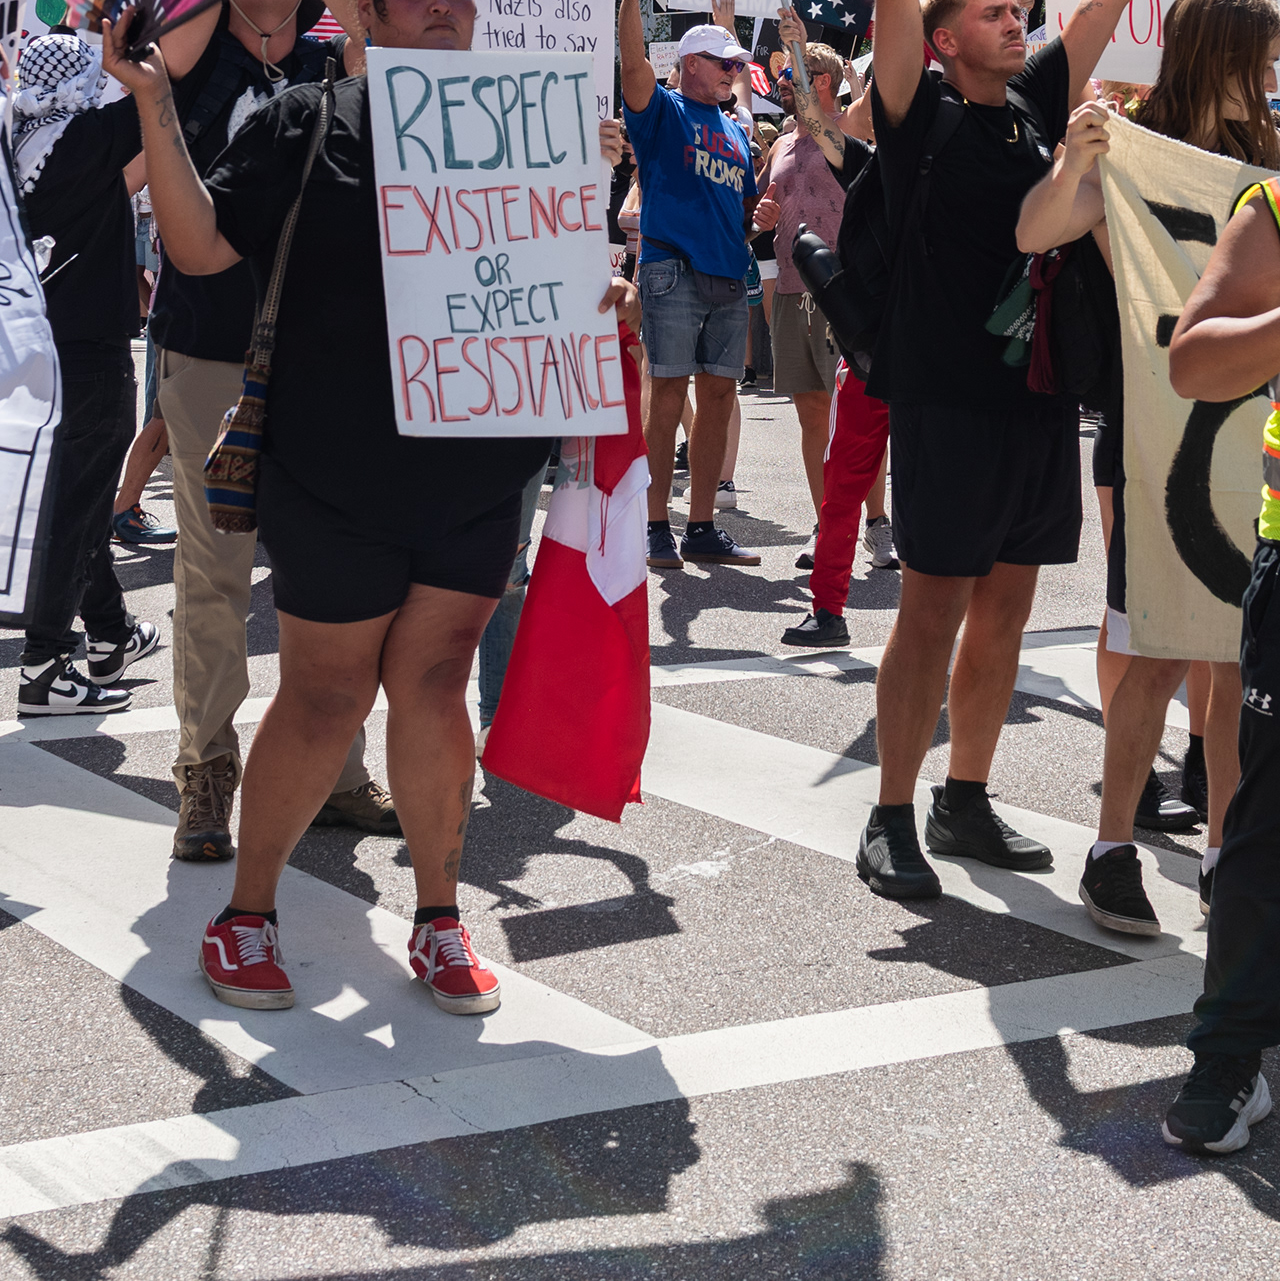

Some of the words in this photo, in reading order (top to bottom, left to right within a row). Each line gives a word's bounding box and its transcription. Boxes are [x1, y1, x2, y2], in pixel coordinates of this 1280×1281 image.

[482, 21, 525, 48] tried
[535, 24, 556, 49] to
[756, 45, 769, 56] FOR
[385, 65, 589, 175] RESPECT
[380, 184, 603, 257] EXISTENCE
[475, 254, 511, 287] OR
[447, 282, 563, 334] EXPECT
[397, 331, 625, 424] RESISTANCE
